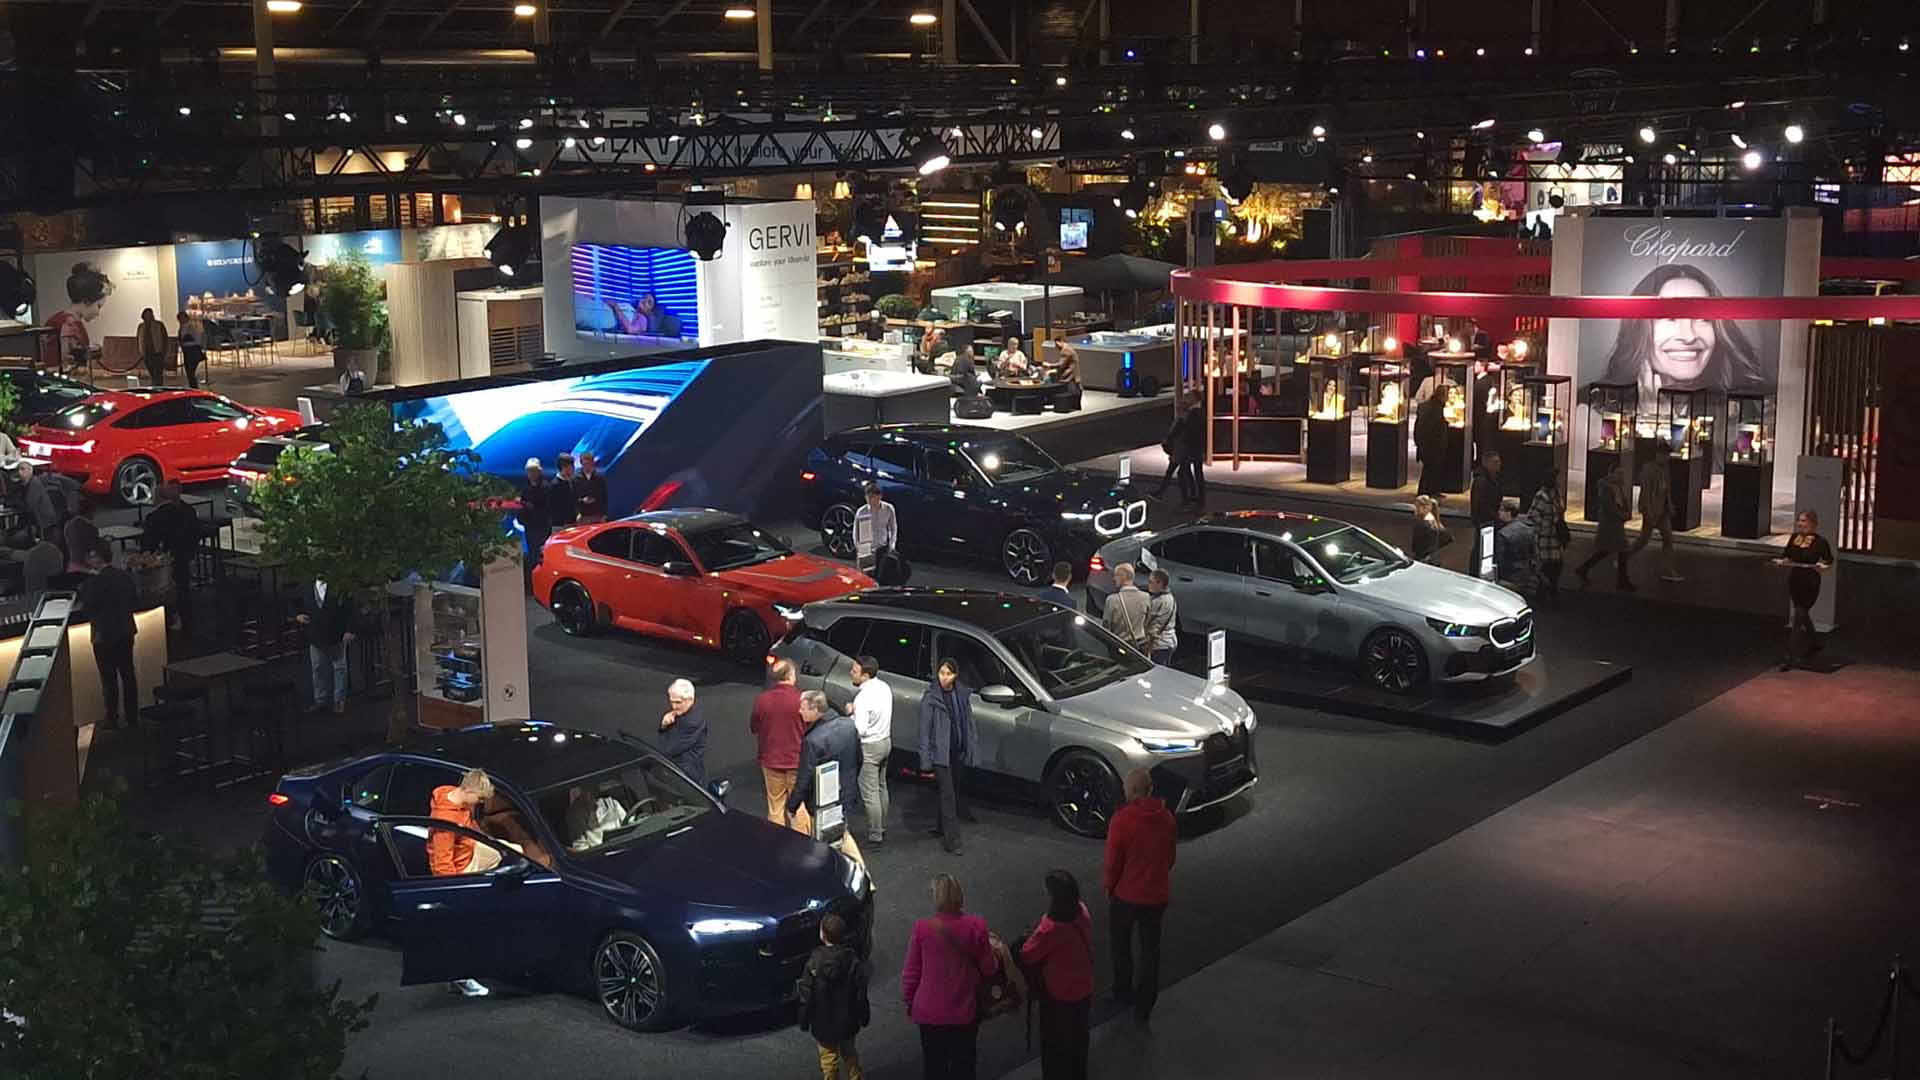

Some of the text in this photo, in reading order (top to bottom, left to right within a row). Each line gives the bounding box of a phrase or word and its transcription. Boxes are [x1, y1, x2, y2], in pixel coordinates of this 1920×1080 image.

[831, 142, 890, 160] lifstyle
[749, 223, 810, 250] GERVI
[1623, 224, 1745, 264] Chopard
